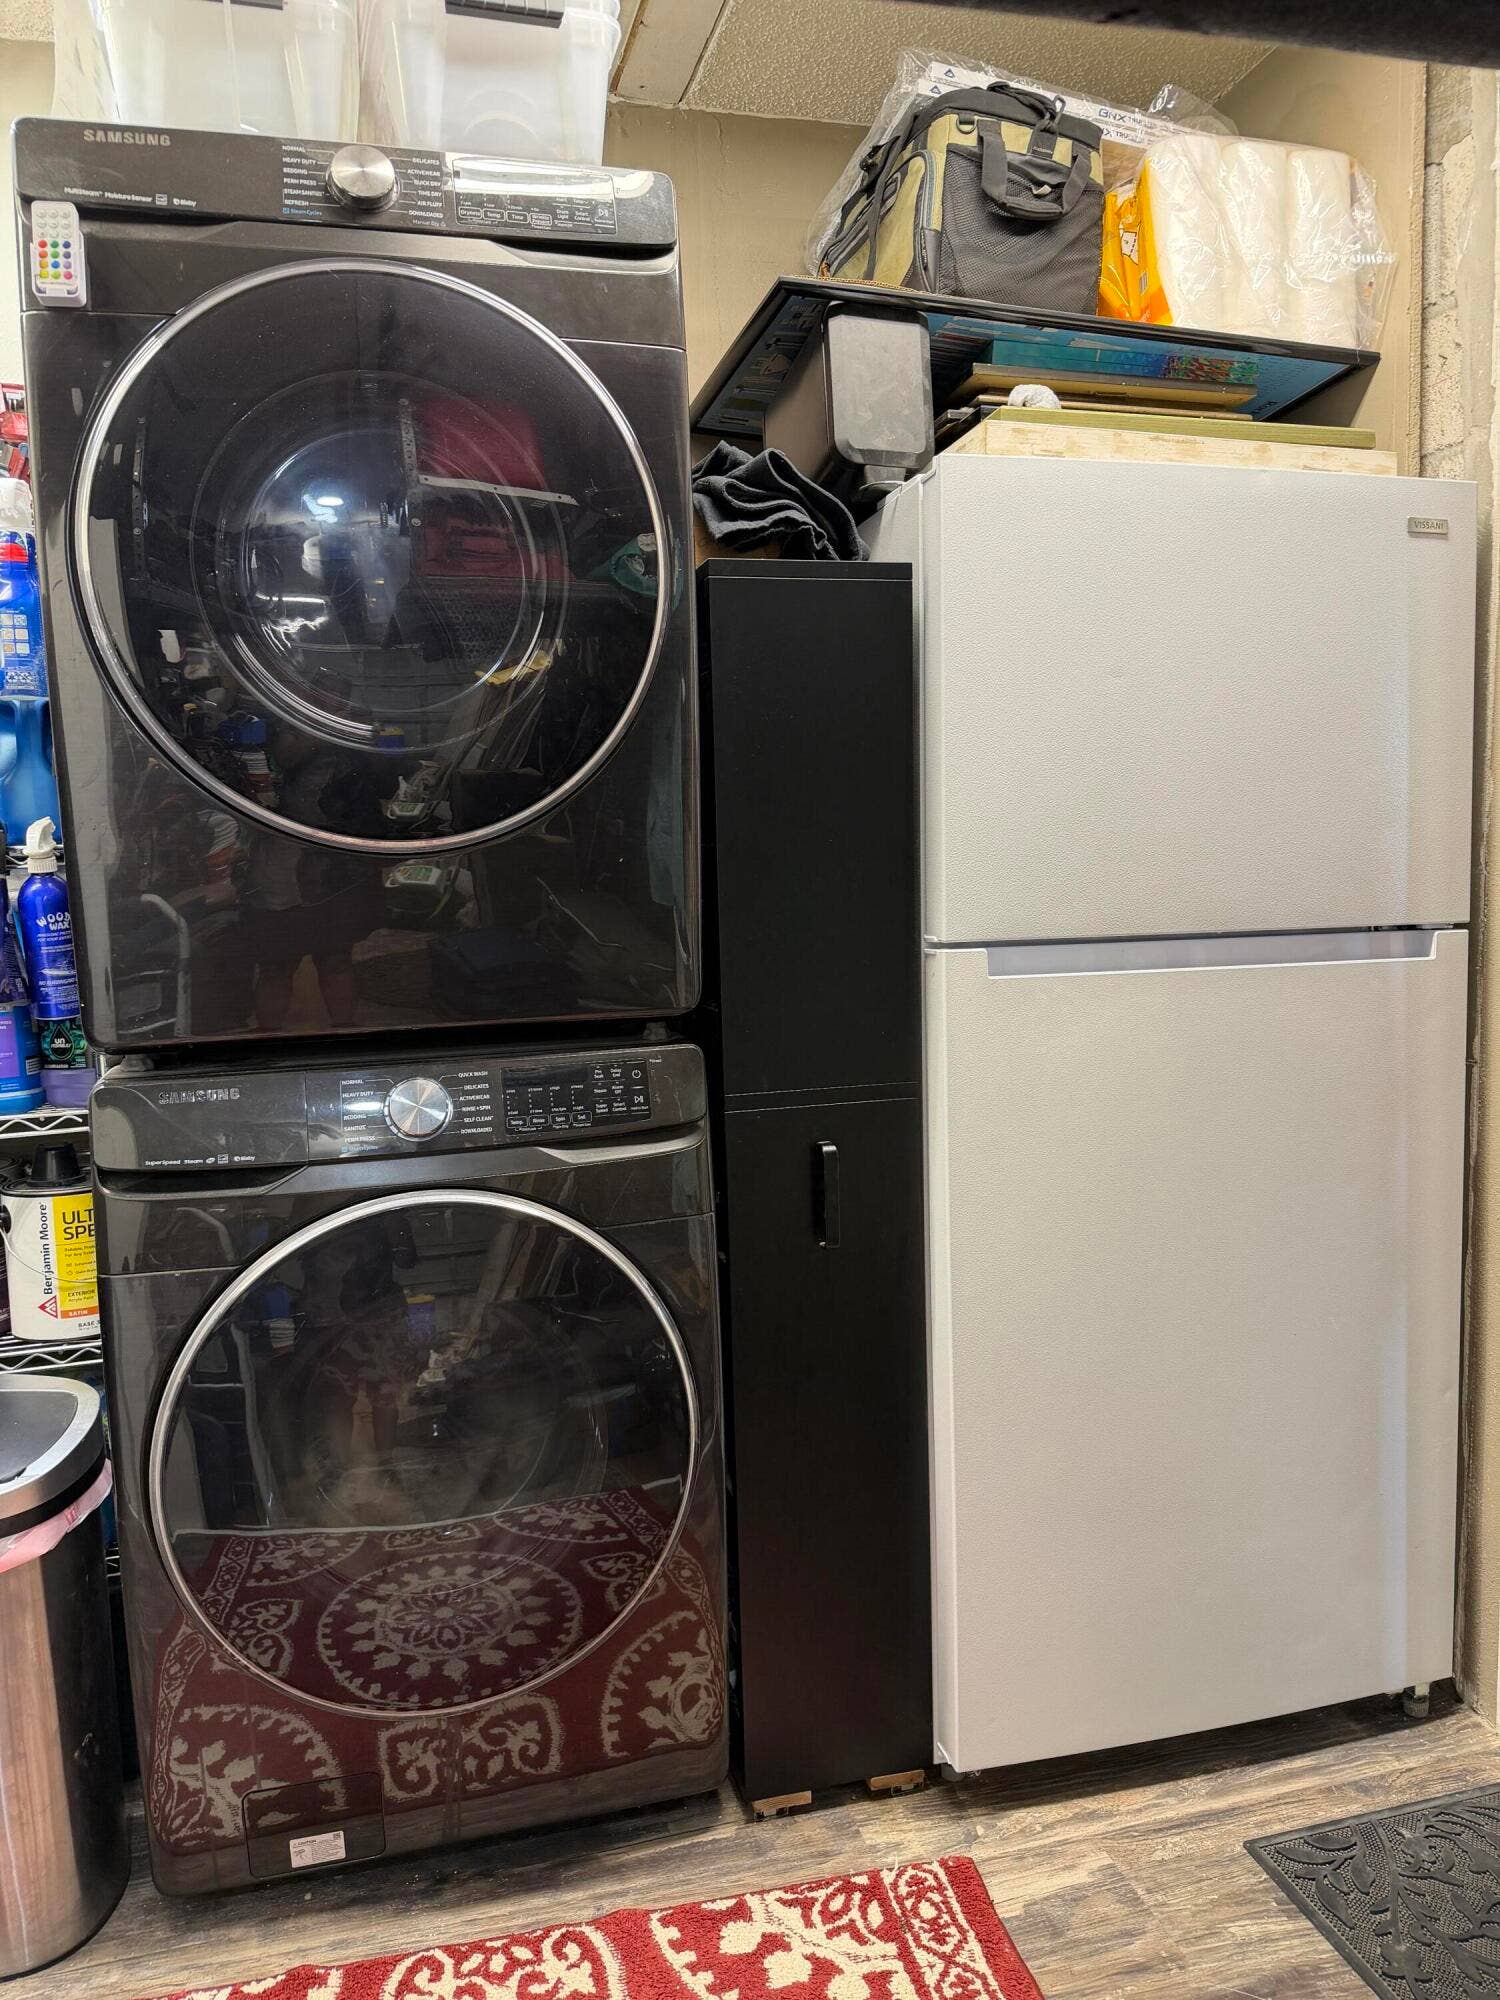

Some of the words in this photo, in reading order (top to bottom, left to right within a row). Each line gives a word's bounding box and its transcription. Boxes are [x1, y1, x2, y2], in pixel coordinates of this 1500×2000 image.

[83, 128, 171, 147] SAMSUNG
[282, 145, 306, 153] NORMAL
[282, 157, 300, 165] HEAVY
[1414, 520, 1444, 530] VISSANI
[36, 911, 72, 928] WOOD
[49, 921, 70, 931] WAX
[463, 1083, 490, 1091] DELICATES
[158, 1087, 241, 1105] SAMSUNG
[39, 1203, 49, 1240] Moore
[41, 1243, 54, 1295] Benjamin
[69, 1309, 88, 1317] SATIN
